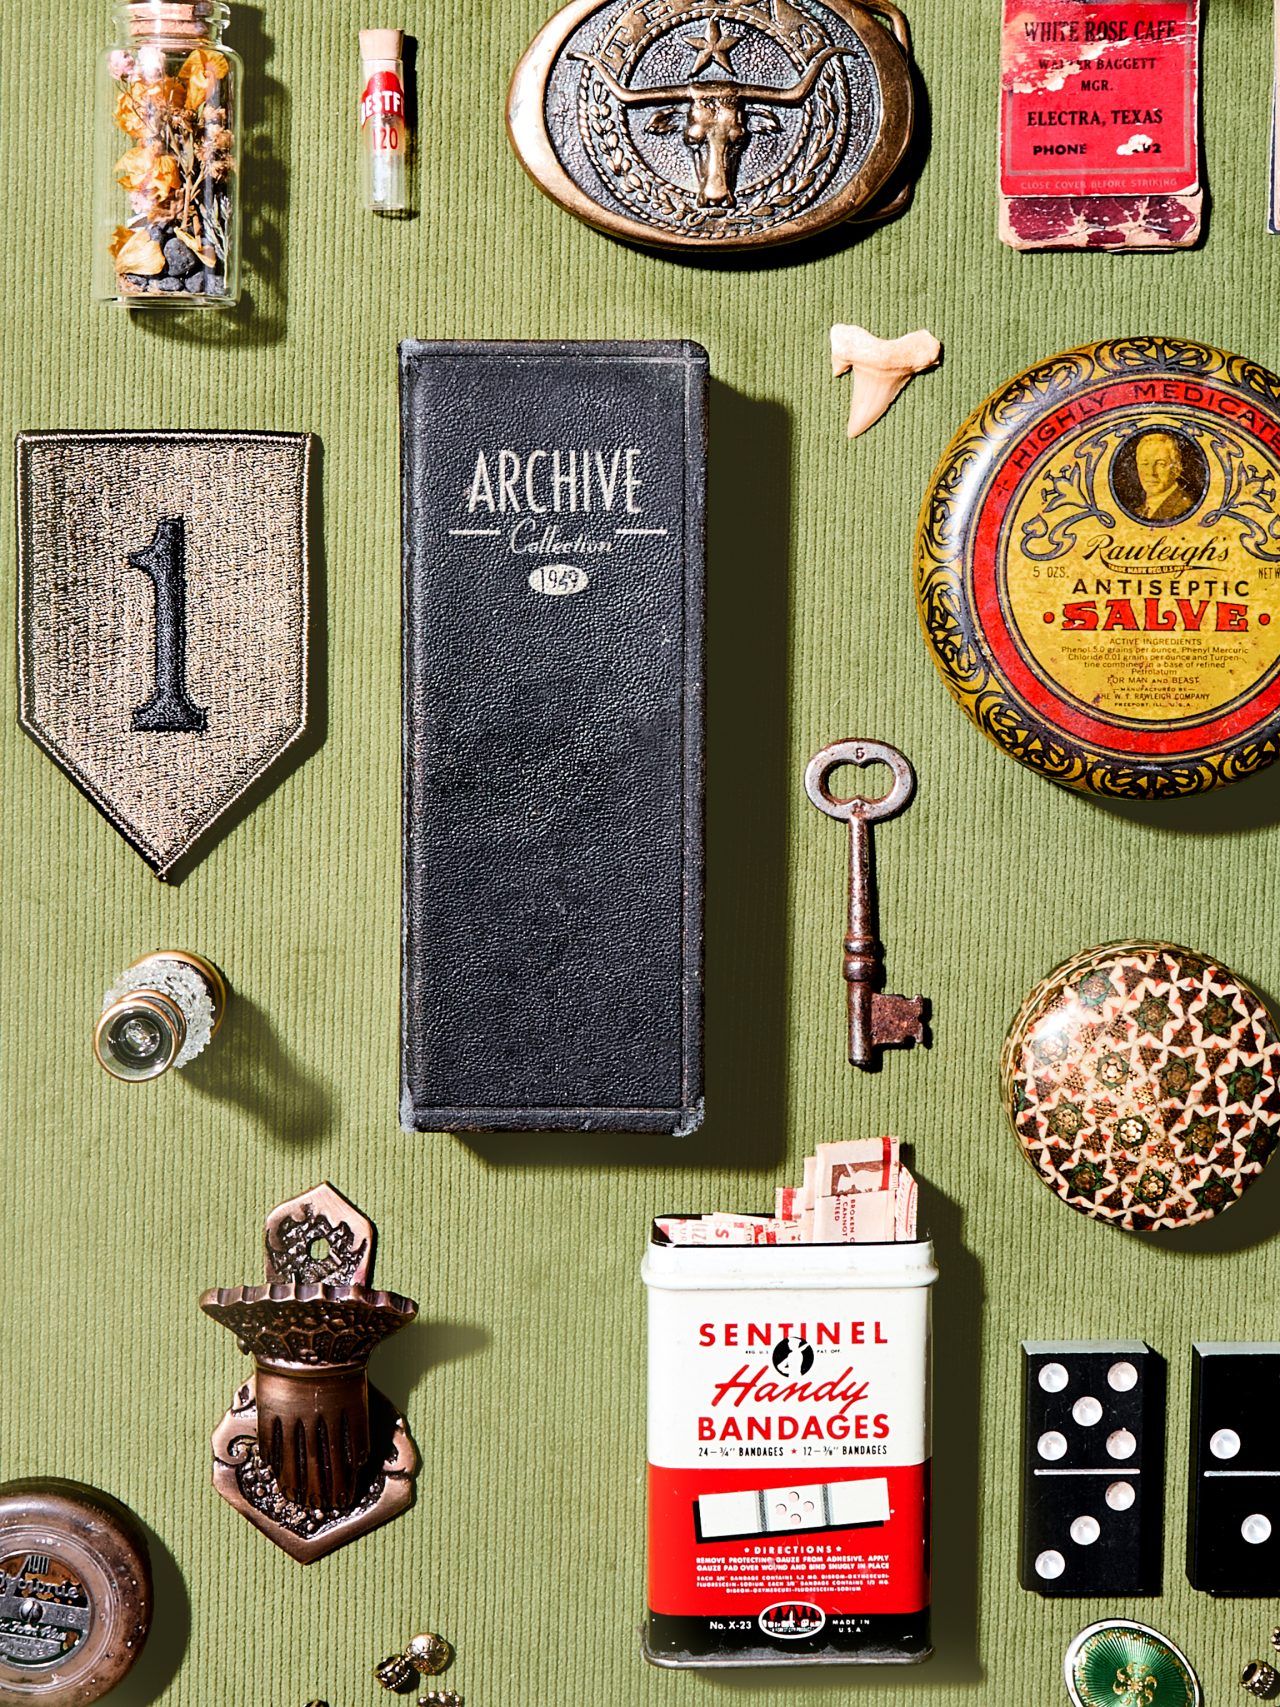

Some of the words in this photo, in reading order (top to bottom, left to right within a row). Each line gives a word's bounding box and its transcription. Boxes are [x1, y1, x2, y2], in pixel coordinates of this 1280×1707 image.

[1024, 21, 1079, 42] WHITE
[1084, 20, 1128, 41] ROSE
[1096, 57, 1157, 70] BAGGETT
[1081, 79, 1114, 92] MGR.
[1027, 110, 1106, 127] ELECTRA,
[1111, 109, 1163, 124] TEXAS
[373, 127, 399, 150] 120
[1032, 144, 1087, 156] PHONE
[1021, 181, 1050, 190] CLOSE
[1055, 180, 1087, 189] COVER
[1091, 179, 1125, 188] BEFORE
[1130, 177, 1178, 188] STRIKING
[1012, 391, 1107, 470] HIGHLY
[467, 449, 643, 514] ARCHIVE
[511, 518, 612, 554] Collection
[1082, 533, 1229, 579] Rawleigh's
[1033, 568, 1041, 578] 5
[1047, 566, 1070, 578] OZS.
[1258, 567, 1273, 579] NET
[1072, 578, 1250, 597] ANTISEPTIC
[1061, 597, 1249, 632] SALVE
[128, 514, 208, 733] 1
[1109, 638, 1140, 646] ACTIVE
[1143, 638, 1202, 646] INGREDIENTS
[1107, 646, 1134, 655] grains
[1181, 646, 1211, 656] Phenyl
[1212, 646, 1249, 654] Mercuric
[1150, 655, 1165, 663] per
[1163, 661, 1183, 669] base
[1185, 661, 1195, 669] of
[1196, 660, 1226, 669] refined
[1131, 668, 1177, 676] Petrolatum
[1107, 676, 1125, 684] FOR
[1128, 676, 1149, 684] MAN
[1171, 676, 1200, 684] BEAST
[699, 1321, 888, 1347] SENTINEL
[711, 1364, 870, 1415] Handy
[698, 1413, 890, 1441] BANDAGES
[738, 1447, 784, 1457] BANDAGES
[842, 1445, 888, 1456] BANDAGES
[754, 1546, 832, 1555] DIRECTIONS
[729, 1556, 774, 1564] PROTECTING
[696, 1564, 722, 1572] GAUZE
[724, 1564, 739, 1572] PAD
[740, 1564, 759, 1572] OVER
[709, 1621, 726, 1630] No.
[728, 1621, 752, 1630] X-23
